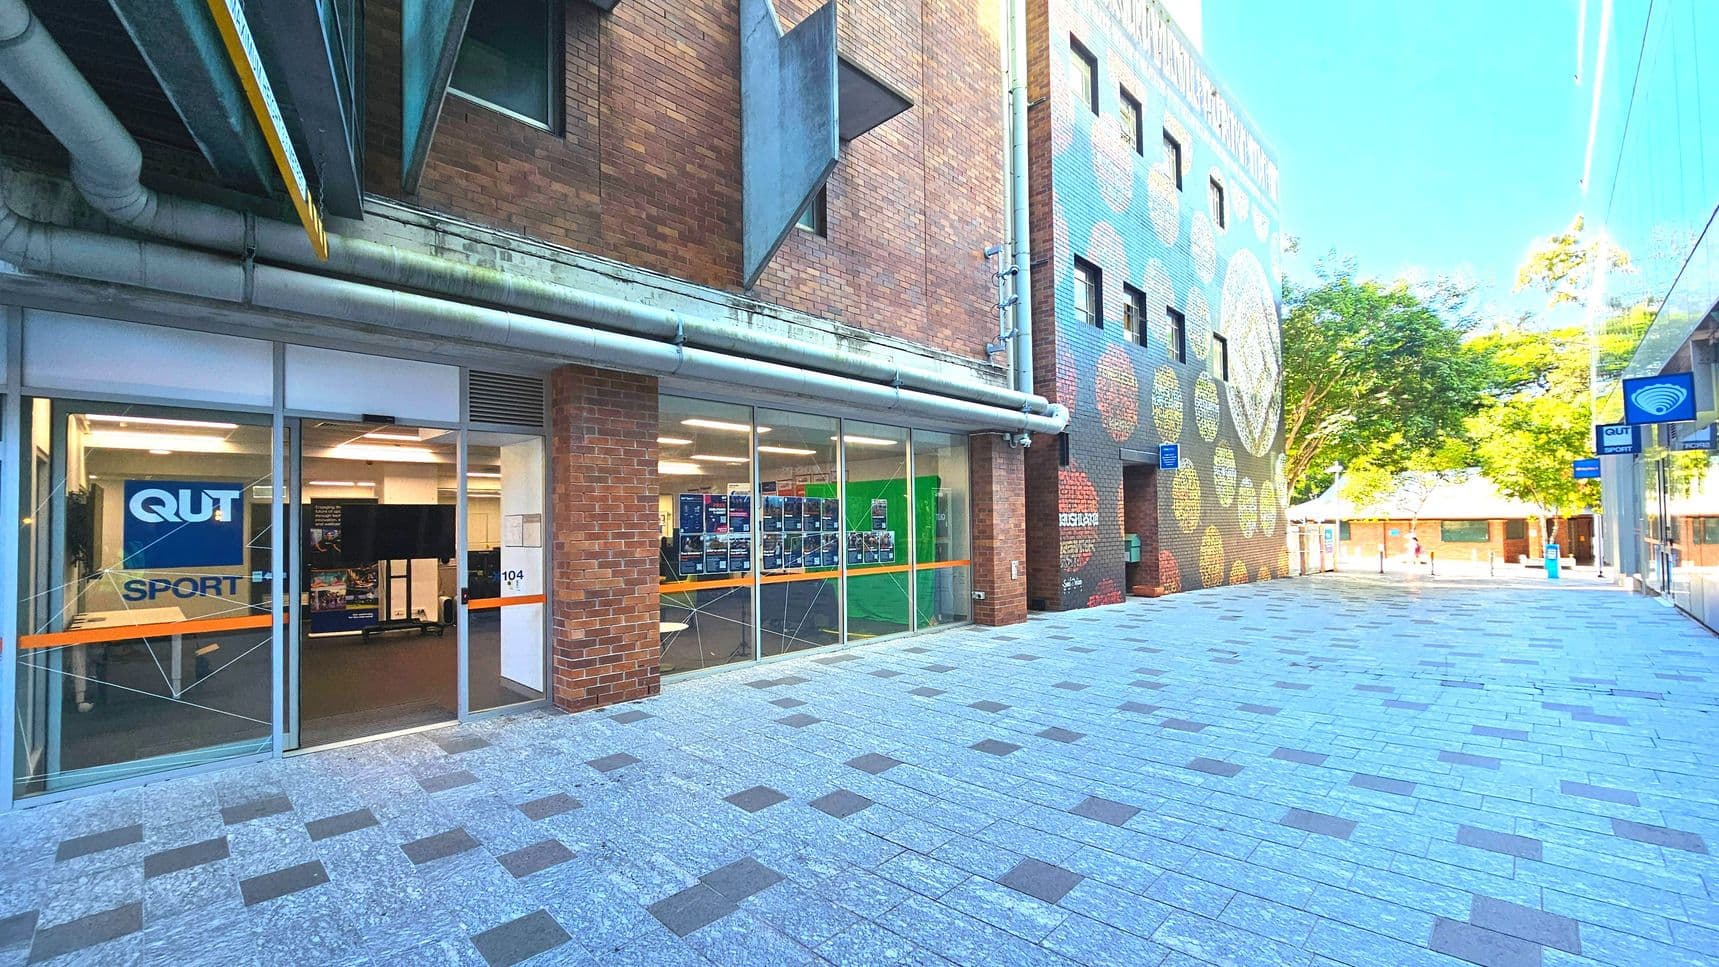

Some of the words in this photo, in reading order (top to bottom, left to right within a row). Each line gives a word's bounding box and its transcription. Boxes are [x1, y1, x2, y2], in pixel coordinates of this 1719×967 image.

[1605, 427, 1630, 436] QUT
[129, 488, 240, 523] QUT
[502, 570, 524, 581] 104
[122, 576, 243, 602] SPORT
